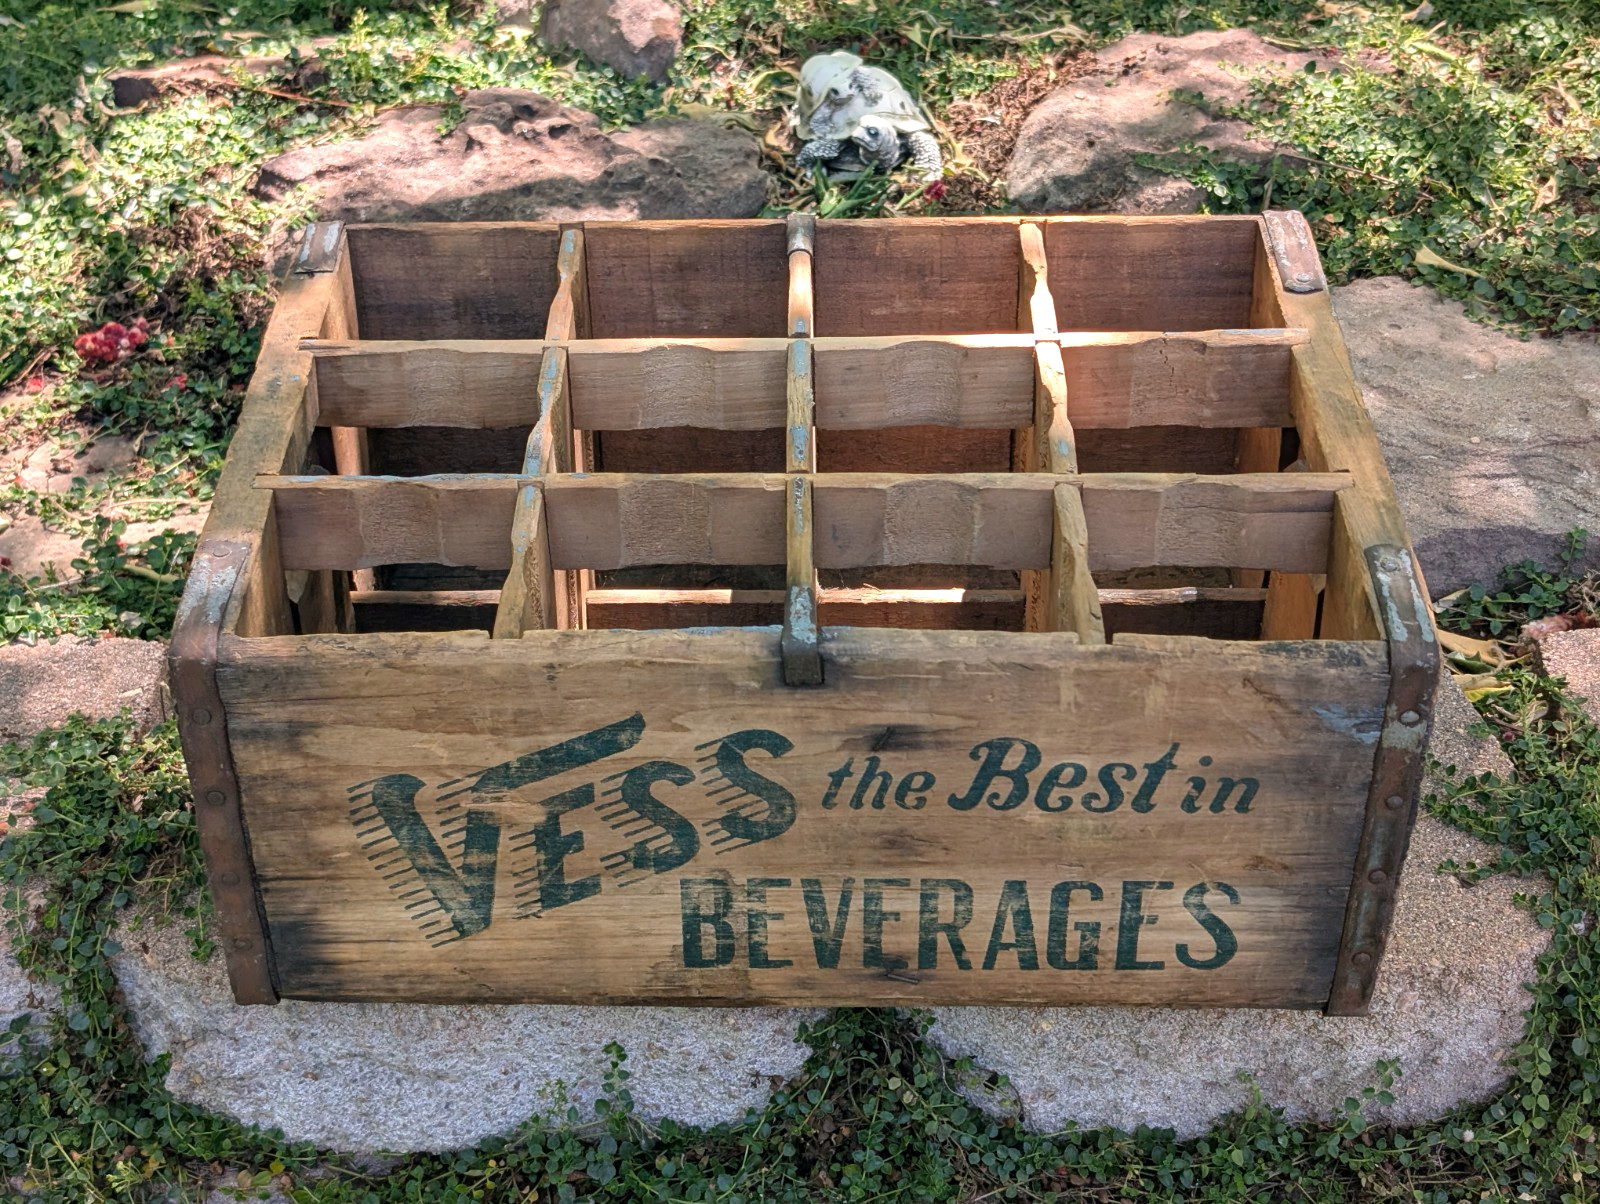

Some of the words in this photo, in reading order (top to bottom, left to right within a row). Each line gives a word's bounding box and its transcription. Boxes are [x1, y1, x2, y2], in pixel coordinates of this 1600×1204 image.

[347, 711, 797, 948] VESS
[821, 756, 936, 810] the
[947, 737, 1178, 814] Best
[1180, 756, 1261, 814] in
[679, 877, 1242, 971] BEVERAGES
